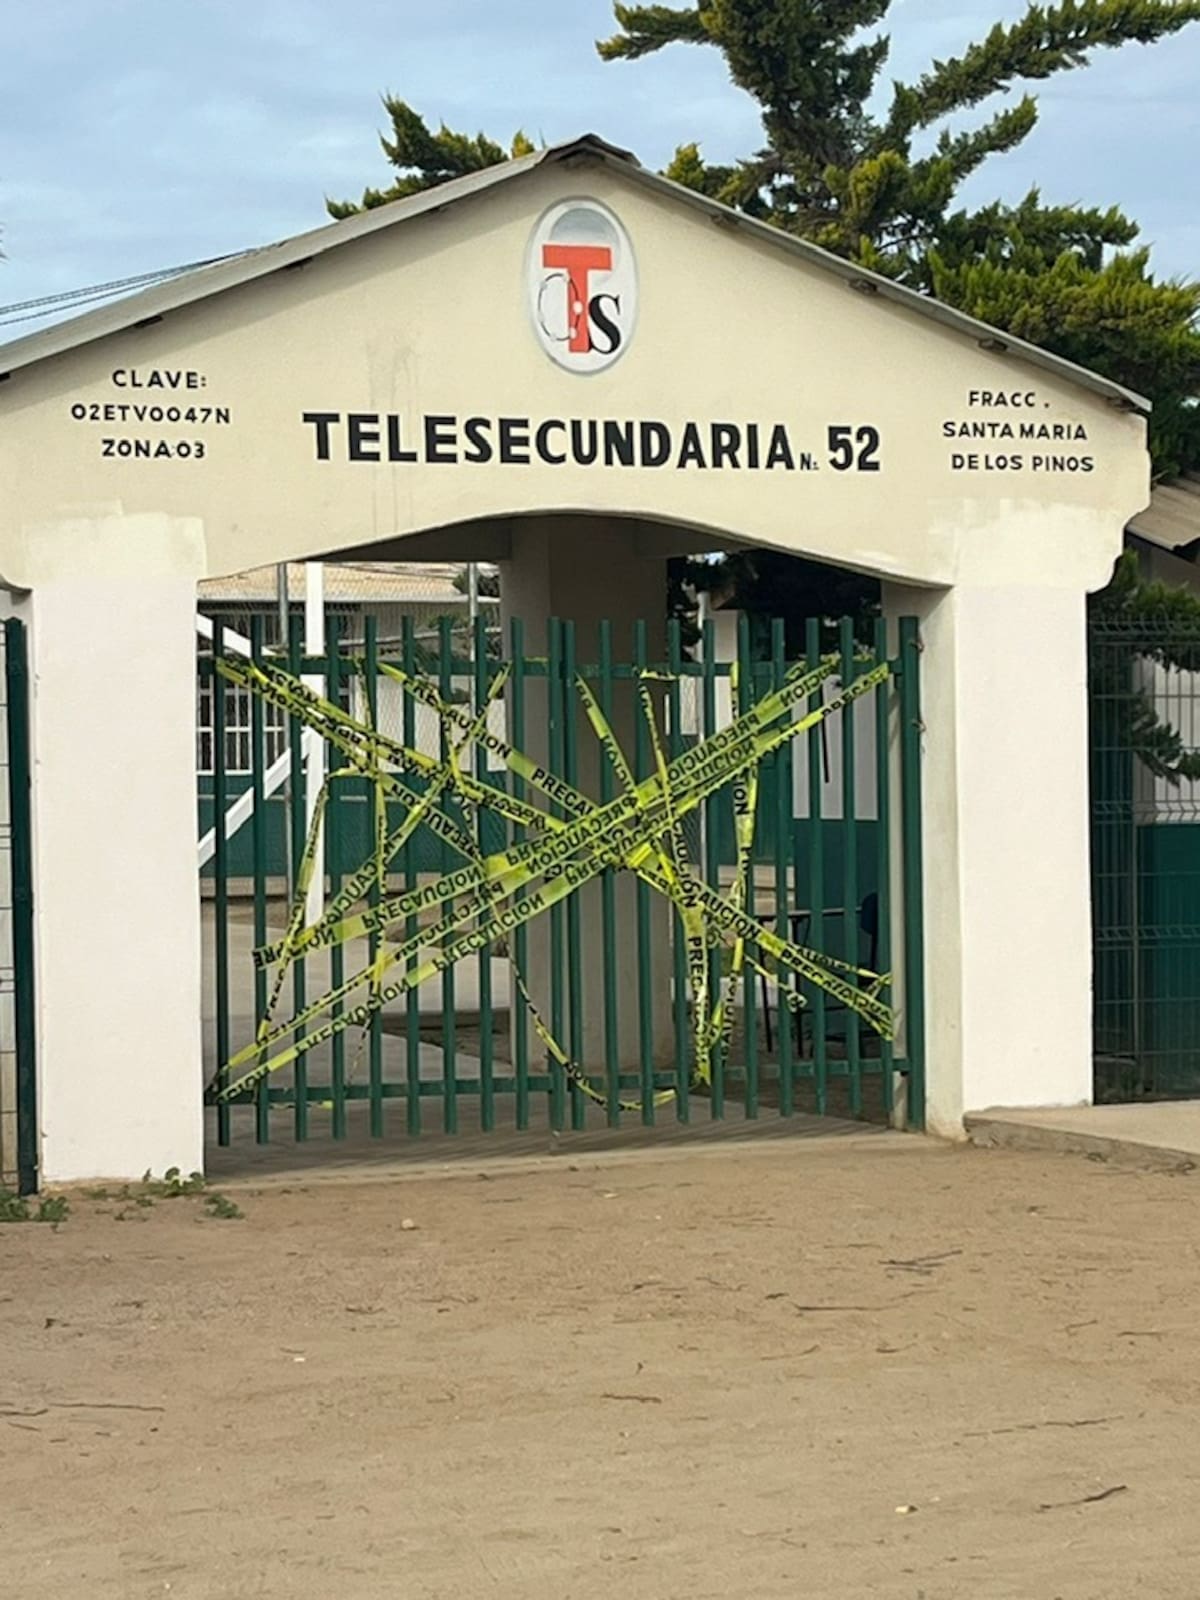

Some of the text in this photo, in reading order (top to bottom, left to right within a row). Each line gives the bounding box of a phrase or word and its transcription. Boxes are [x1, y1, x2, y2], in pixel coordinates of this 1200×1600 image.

[112, 369, 207, 389] CLAVE:
[71, 403, 230, 424] 02ETV0047N
[943, 421, 1087, 440] SANTA MARIA
[302, 412, 796, 470] TELESECUNDARIA
[828, 425, 880, 471] 52
[952, 454, 1094, 472] DE LOS PINOS
